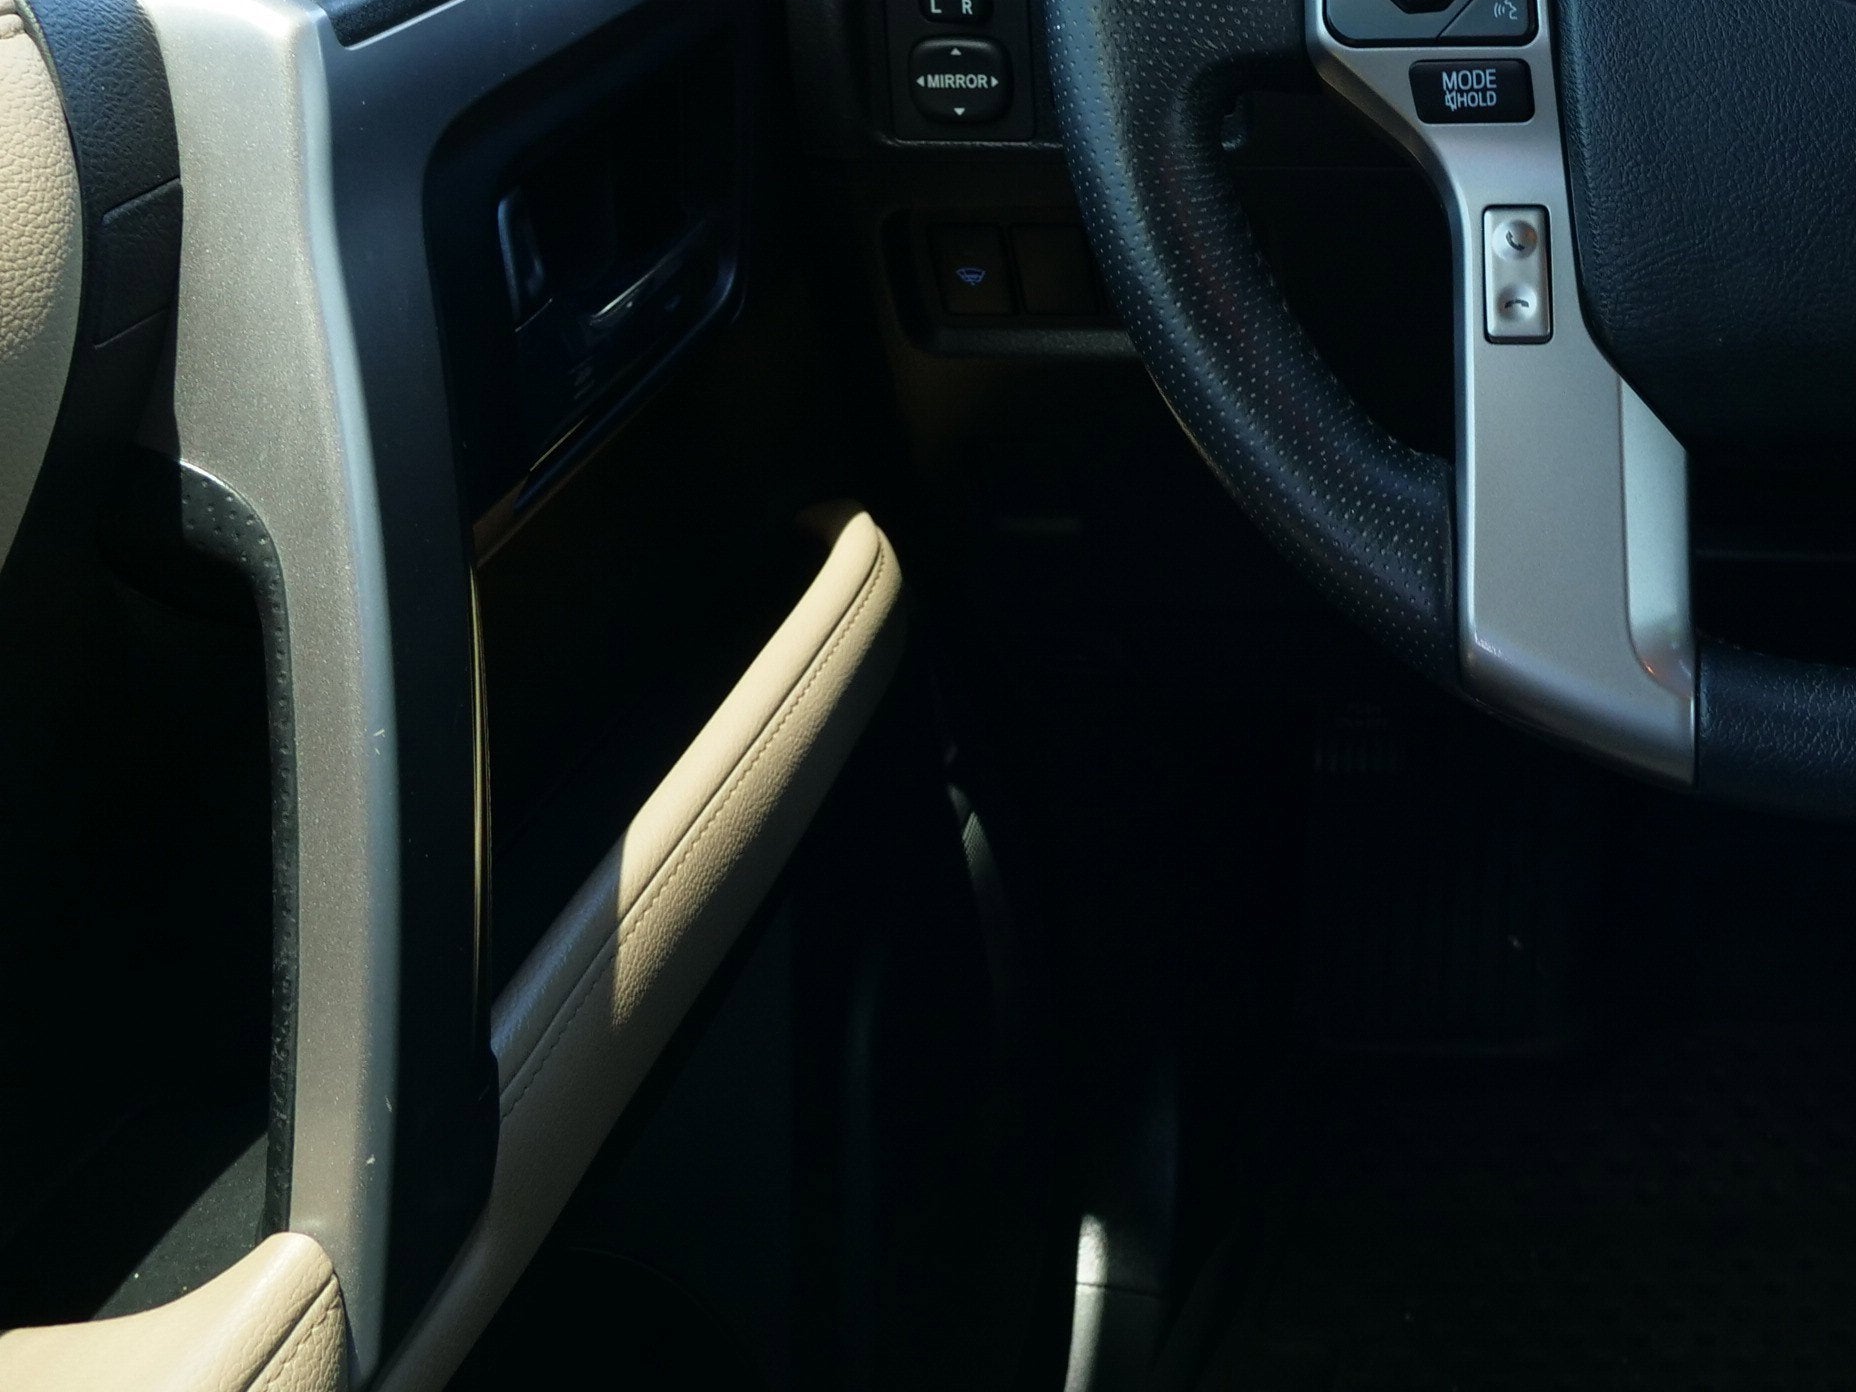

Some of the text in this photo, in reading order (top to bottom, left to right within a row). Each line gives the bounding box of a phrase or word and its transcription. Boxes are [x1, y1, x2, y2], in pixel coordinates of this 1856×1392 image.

[926, 74, 988, 89] MIRROR
[1442, 69, 1497, 91] MODE
[1457, 90, 1497, 108] HOLD
